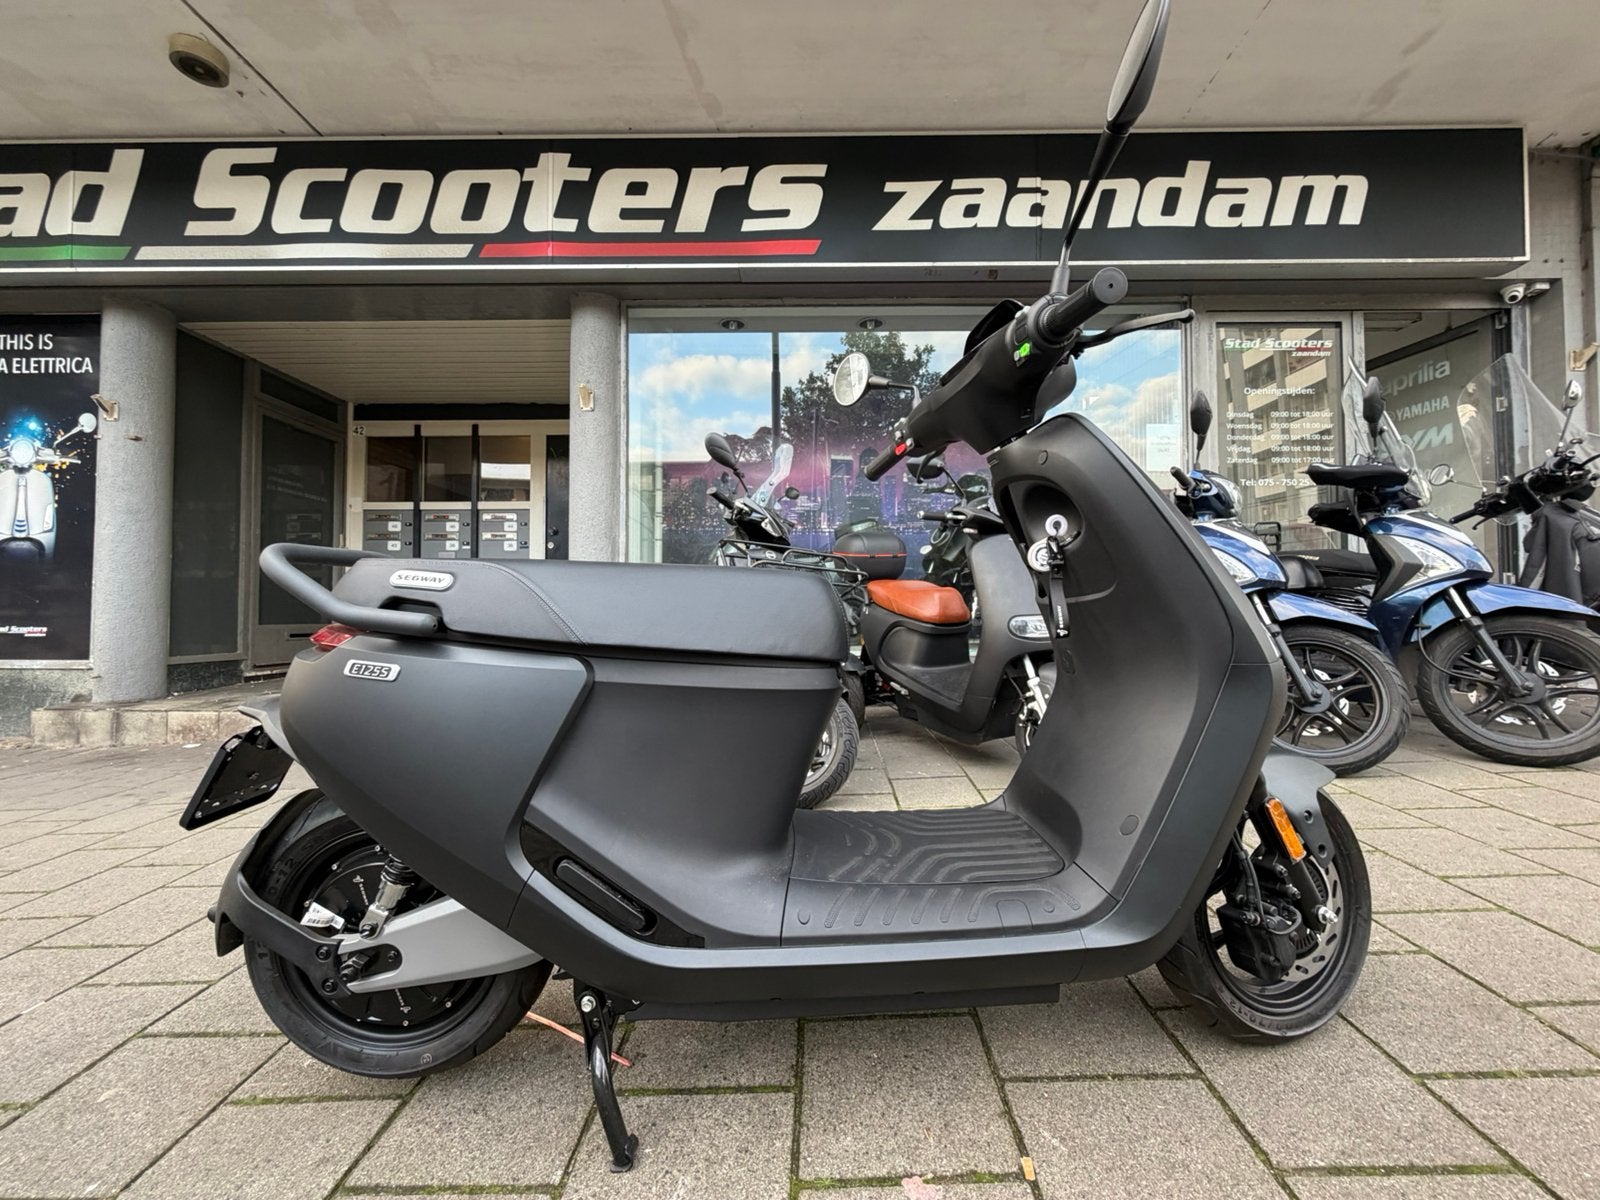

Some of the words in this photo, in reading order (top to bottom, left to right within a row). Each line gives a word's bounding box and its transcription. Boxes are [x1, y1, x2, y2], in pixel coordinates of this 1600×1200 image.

[184, 148, 827, 236] Scooters
[872, 161, 1368, 230] zaandam
[0, 334, 34, 350] THIS
[39, 334, 53, 350] IS
[1224, 338, 1261, 348] Stad
[1264, 338, 1333, 348] Scooters
[12, 357, 93, 373] ELETTRICA
[1382, 360, 1450, 396] aprilia
[1243, 387, 1315, 396] Openingstijden:
[1396, 396, 1450, 421] YAMAHA
[1226, 411, 1254, 419] Dinsdag
[352, 426, 365, 435] 42
[1226, 422, 1262, 430] Woensdag
[1241, 479, 1256, 487] Tel:
[1258, 479, 1275, 487] 075
[1281, 479, 1297, 487] 750
[1299, 479, 1310, 487] 25
[397, 574, 445, 584] SEGWAY
[351, 663, 390, 678] E125S
